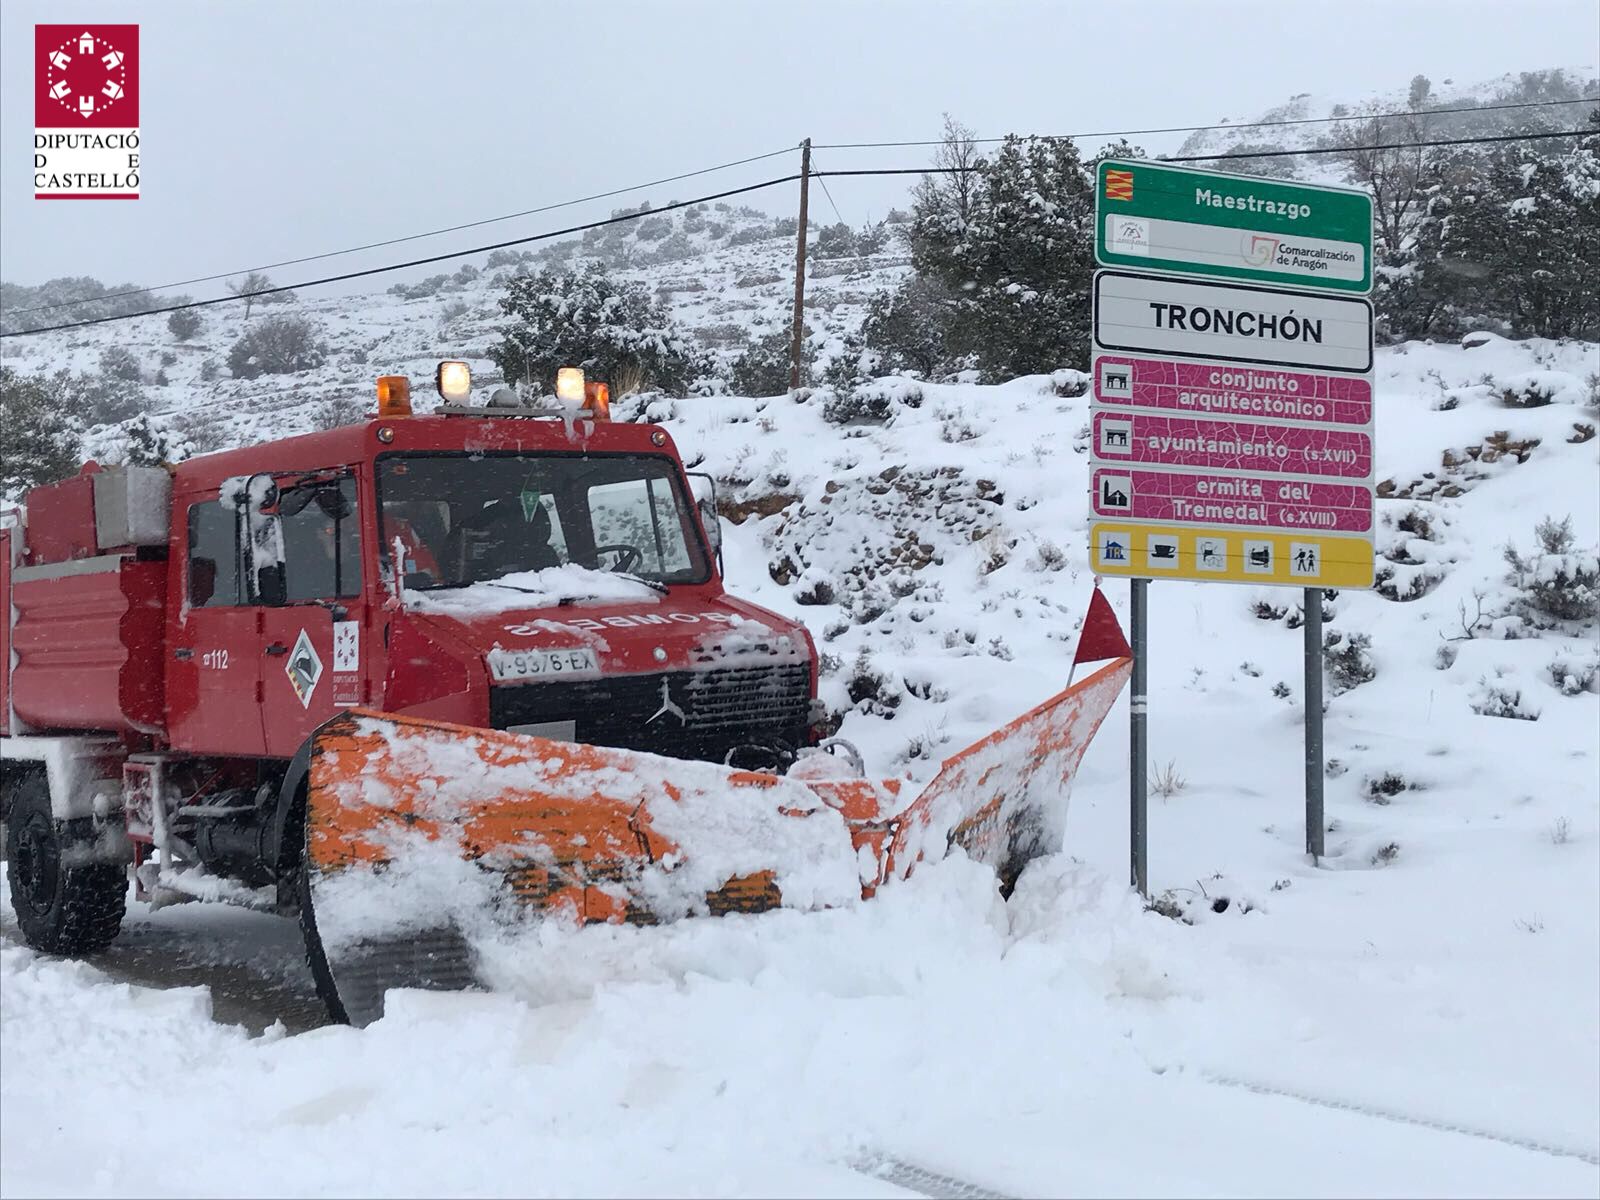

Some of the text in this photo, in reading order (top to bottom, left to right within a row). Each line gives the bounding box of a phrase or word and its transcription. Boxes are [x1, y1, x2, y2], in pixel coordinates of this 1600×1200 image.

[1195, 188, 1311, 220] Maestrazgo
[1276, 255, 1328, 272] de Aragón
[1279, 243, 1356, 262] Comarcalización
[1149, 302, 1323, 344] TRONCHÓN
[1209, 371, 1299, 393] conjunto
[1178, 390, 1326, 417] arquitectónico
[1147, 434, 1358, 465] ayuntamiento (s.XVII)
[1196, 479, 1311, 501] ermita del
[1173, 499, 1338, 528] Tremedal (s.XVIII)
[211, 649, 229, 670] 112
